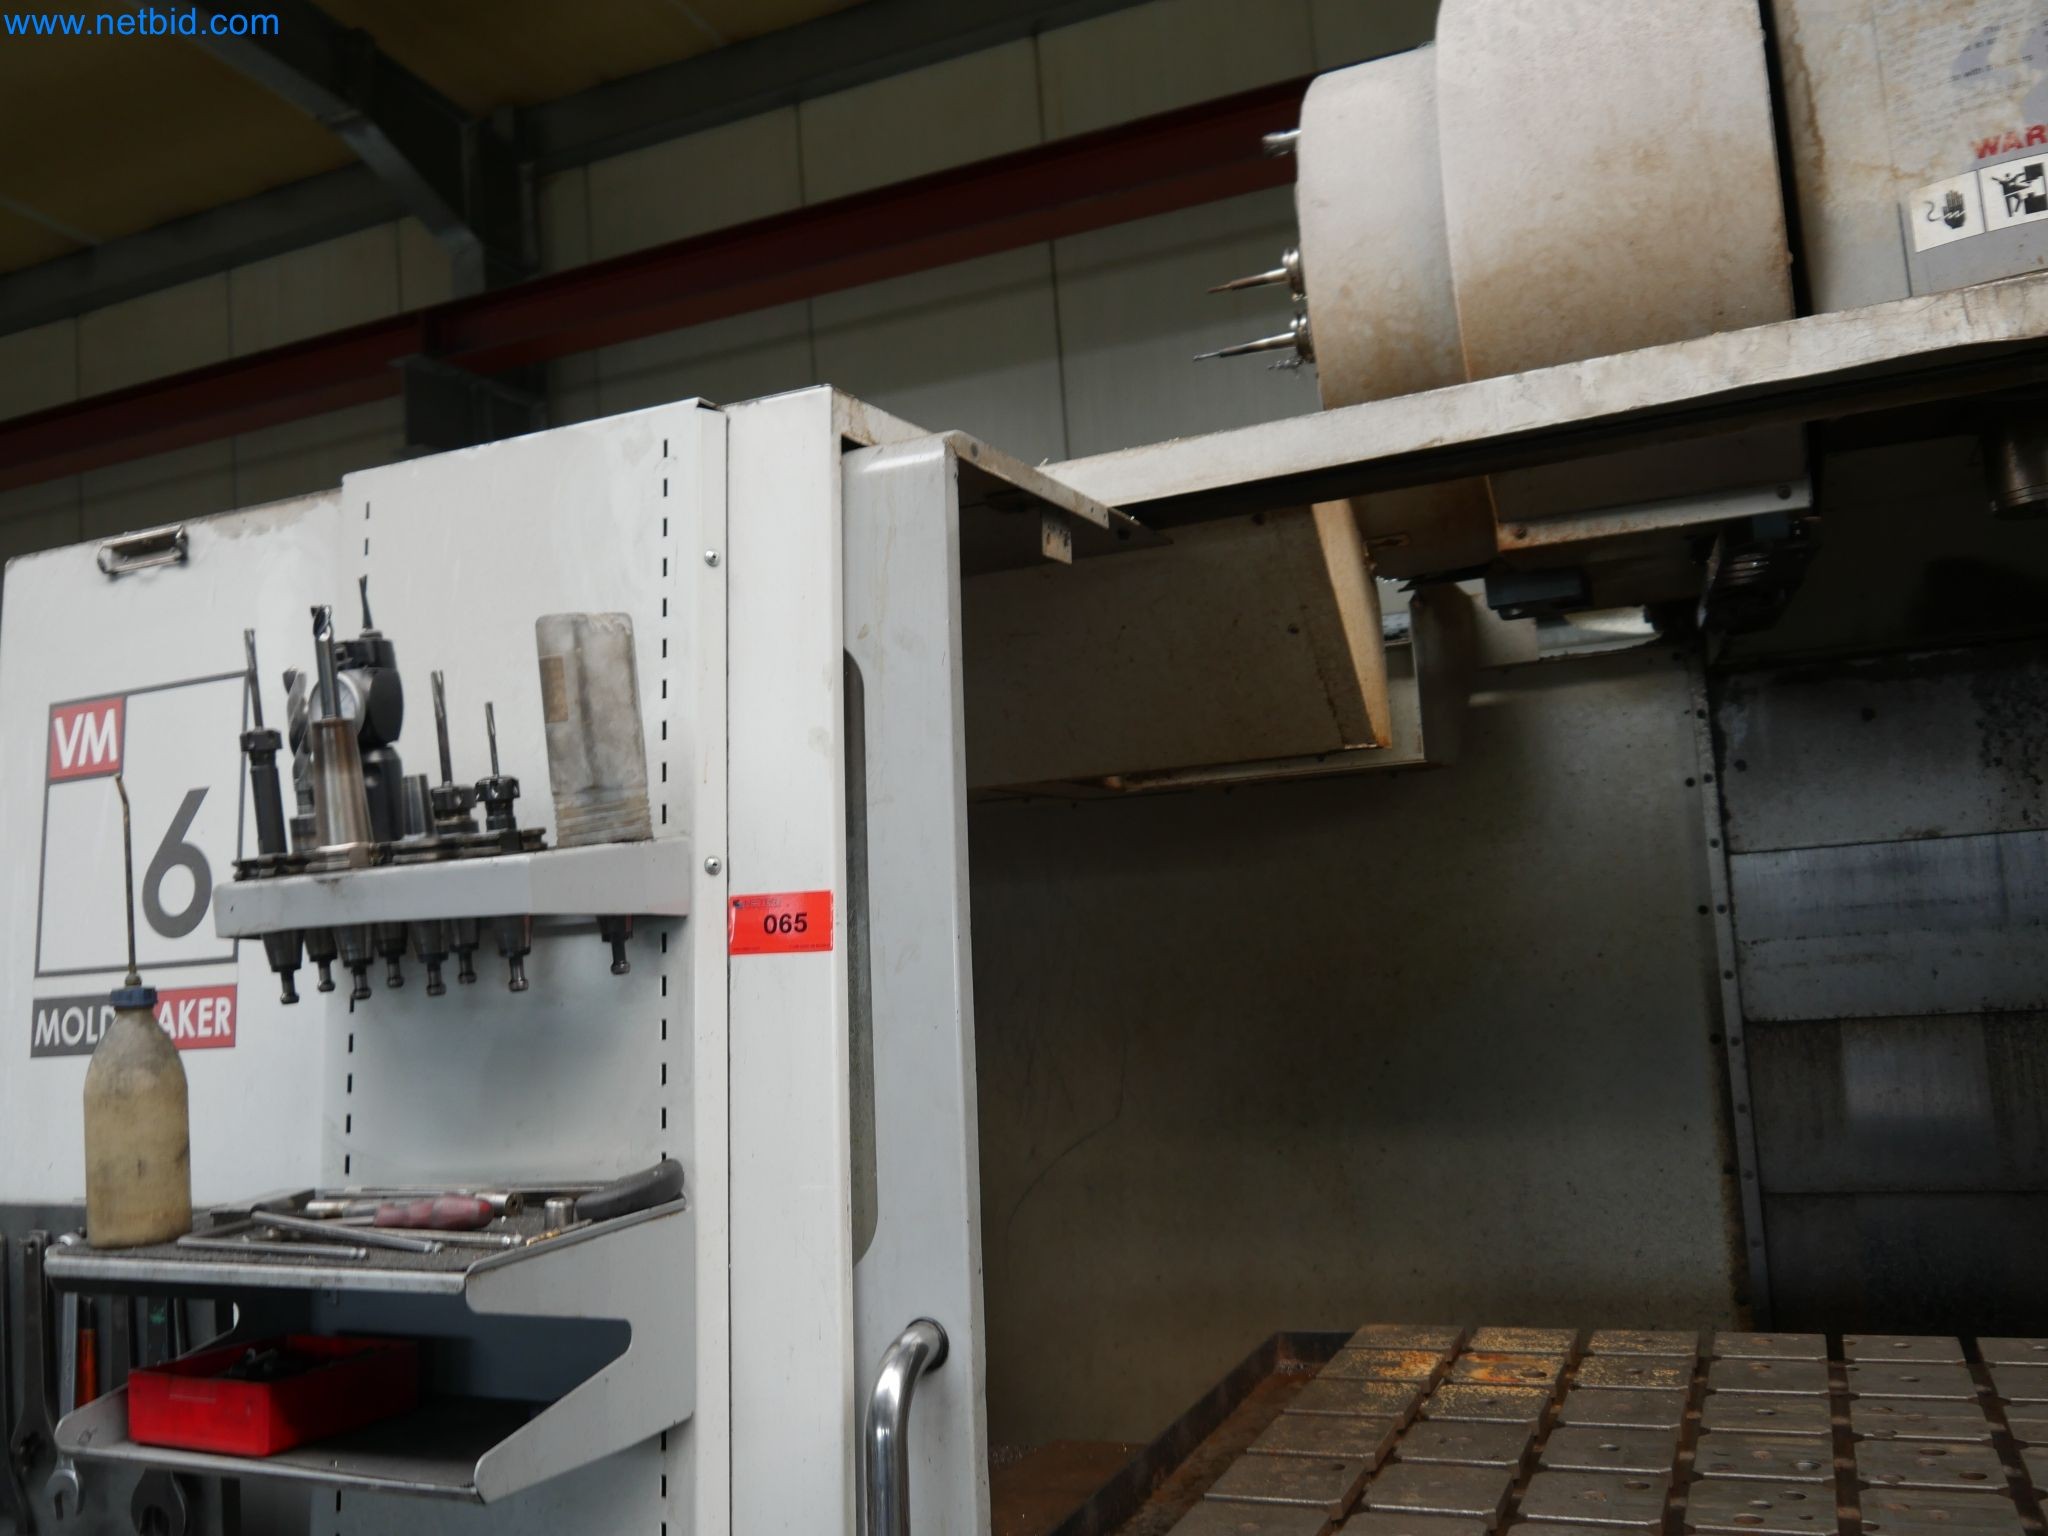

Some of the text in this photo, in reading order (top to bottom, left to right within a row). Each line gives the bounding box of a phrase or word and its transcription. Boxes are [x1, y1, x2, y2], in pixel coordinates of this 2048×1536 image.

[54, 708, 118, 769] VM
[142, 786, 213, 938] 6
[763, 912, 808, 934] 065
[34, 997, 232, 1047] MOLDAKER
